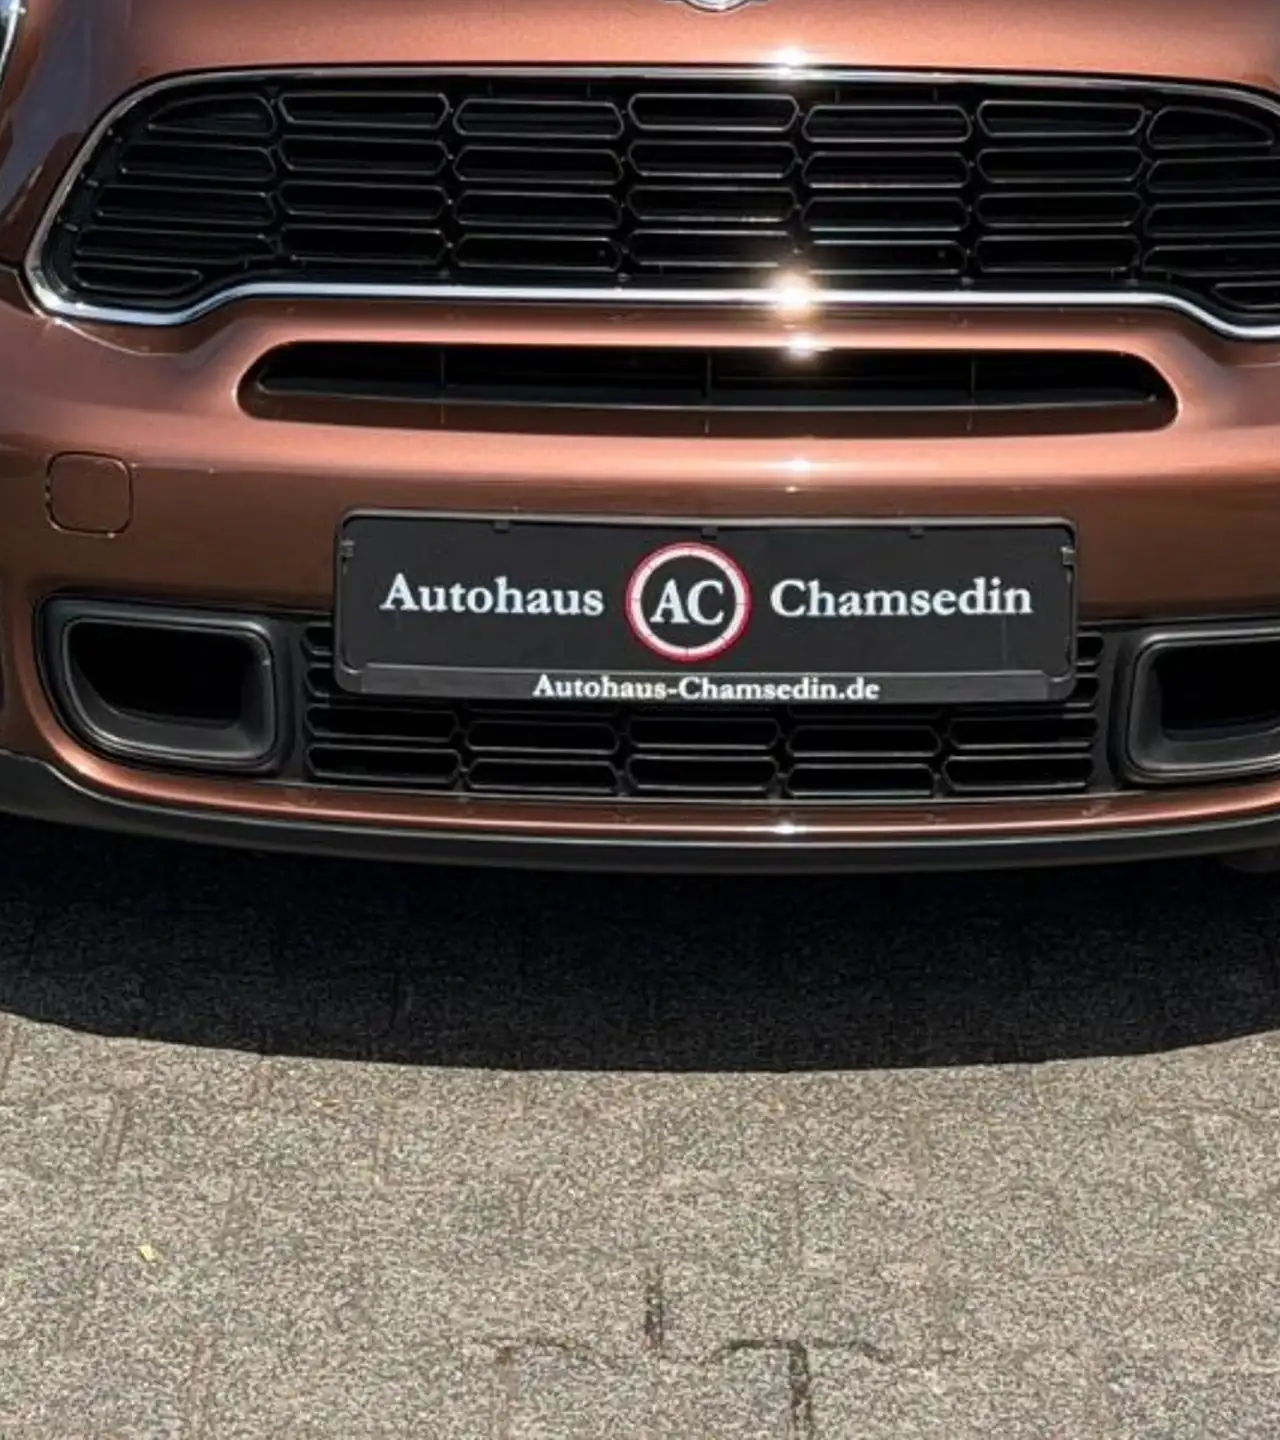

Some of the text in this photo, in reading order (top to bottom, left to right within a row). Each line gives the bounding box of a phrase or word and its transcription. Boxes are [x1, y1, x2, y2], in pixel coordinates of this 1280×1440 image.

[379, 573, 1034, 626] Autohaus AC Chamsedin
[532, 673, 881, 702] Autohaus-Chamsedin.de
